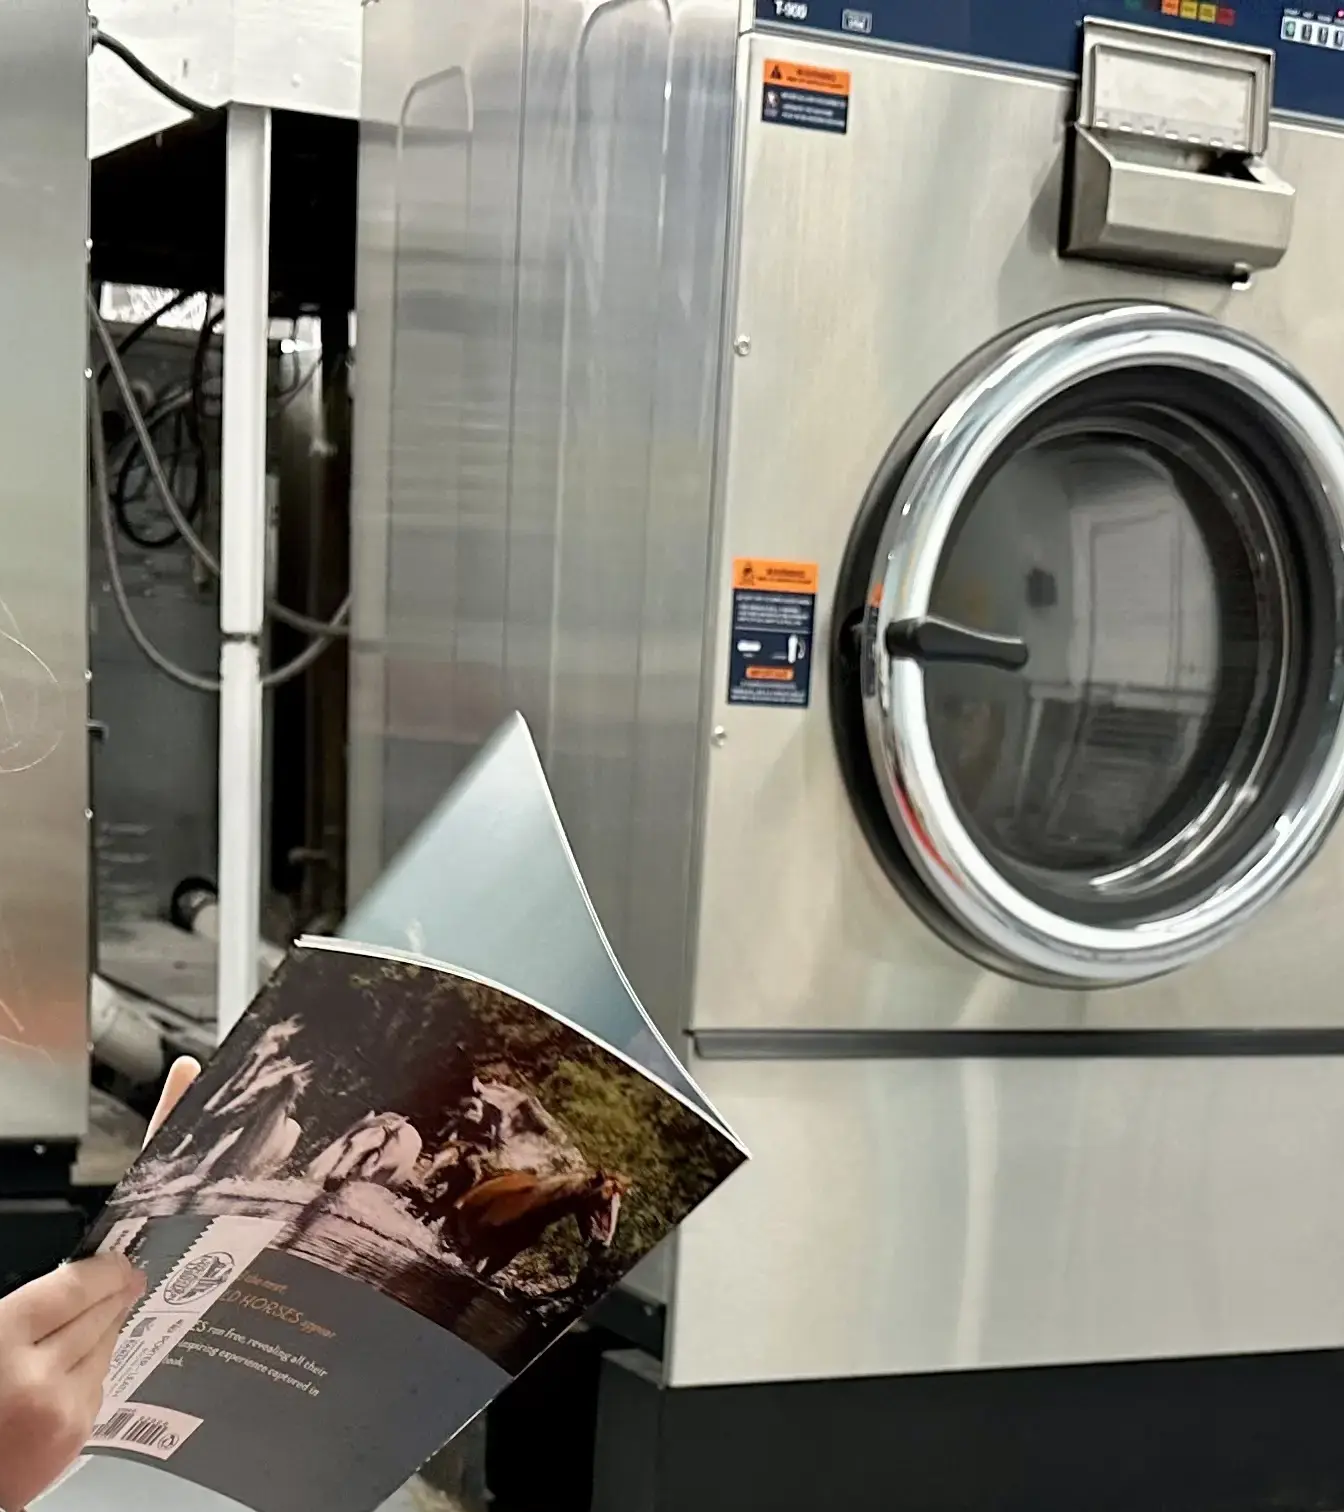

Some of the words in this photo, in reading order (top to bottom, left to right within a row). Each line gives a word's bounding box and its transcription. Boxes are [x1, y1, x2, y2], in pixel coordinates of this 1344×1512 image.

[243, 1292, 304, 1324] HORSES
[290, 1352, 306, 1366] all
[303, 1357, 329, 1378] their
